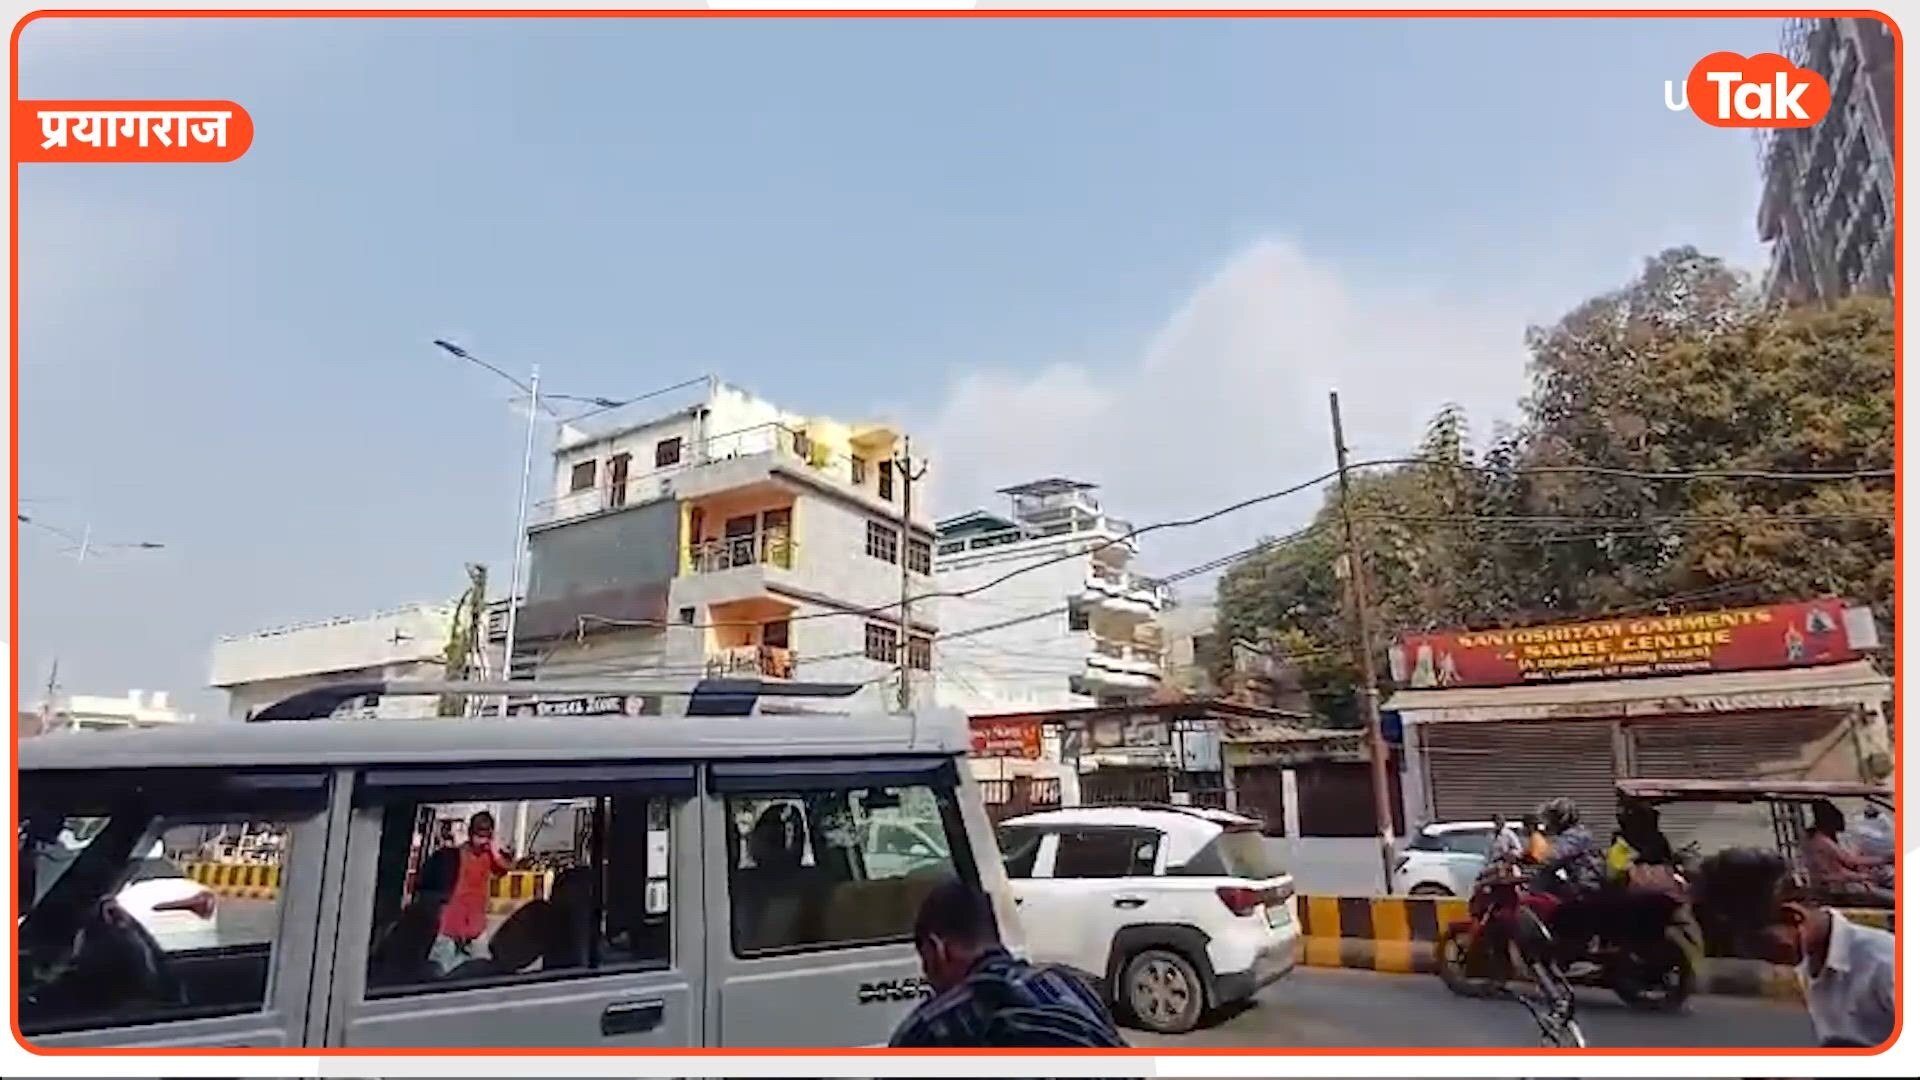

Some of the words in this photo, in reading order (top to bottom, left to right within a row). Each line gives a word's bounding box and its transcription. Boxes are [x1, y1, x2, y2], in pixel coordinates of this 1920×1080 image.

[1629, 610, 1772, 635] GARMENTS
[1523, 641, 1613, 658] SAREE
[1622, 629, 1732, 651] CENTRE
